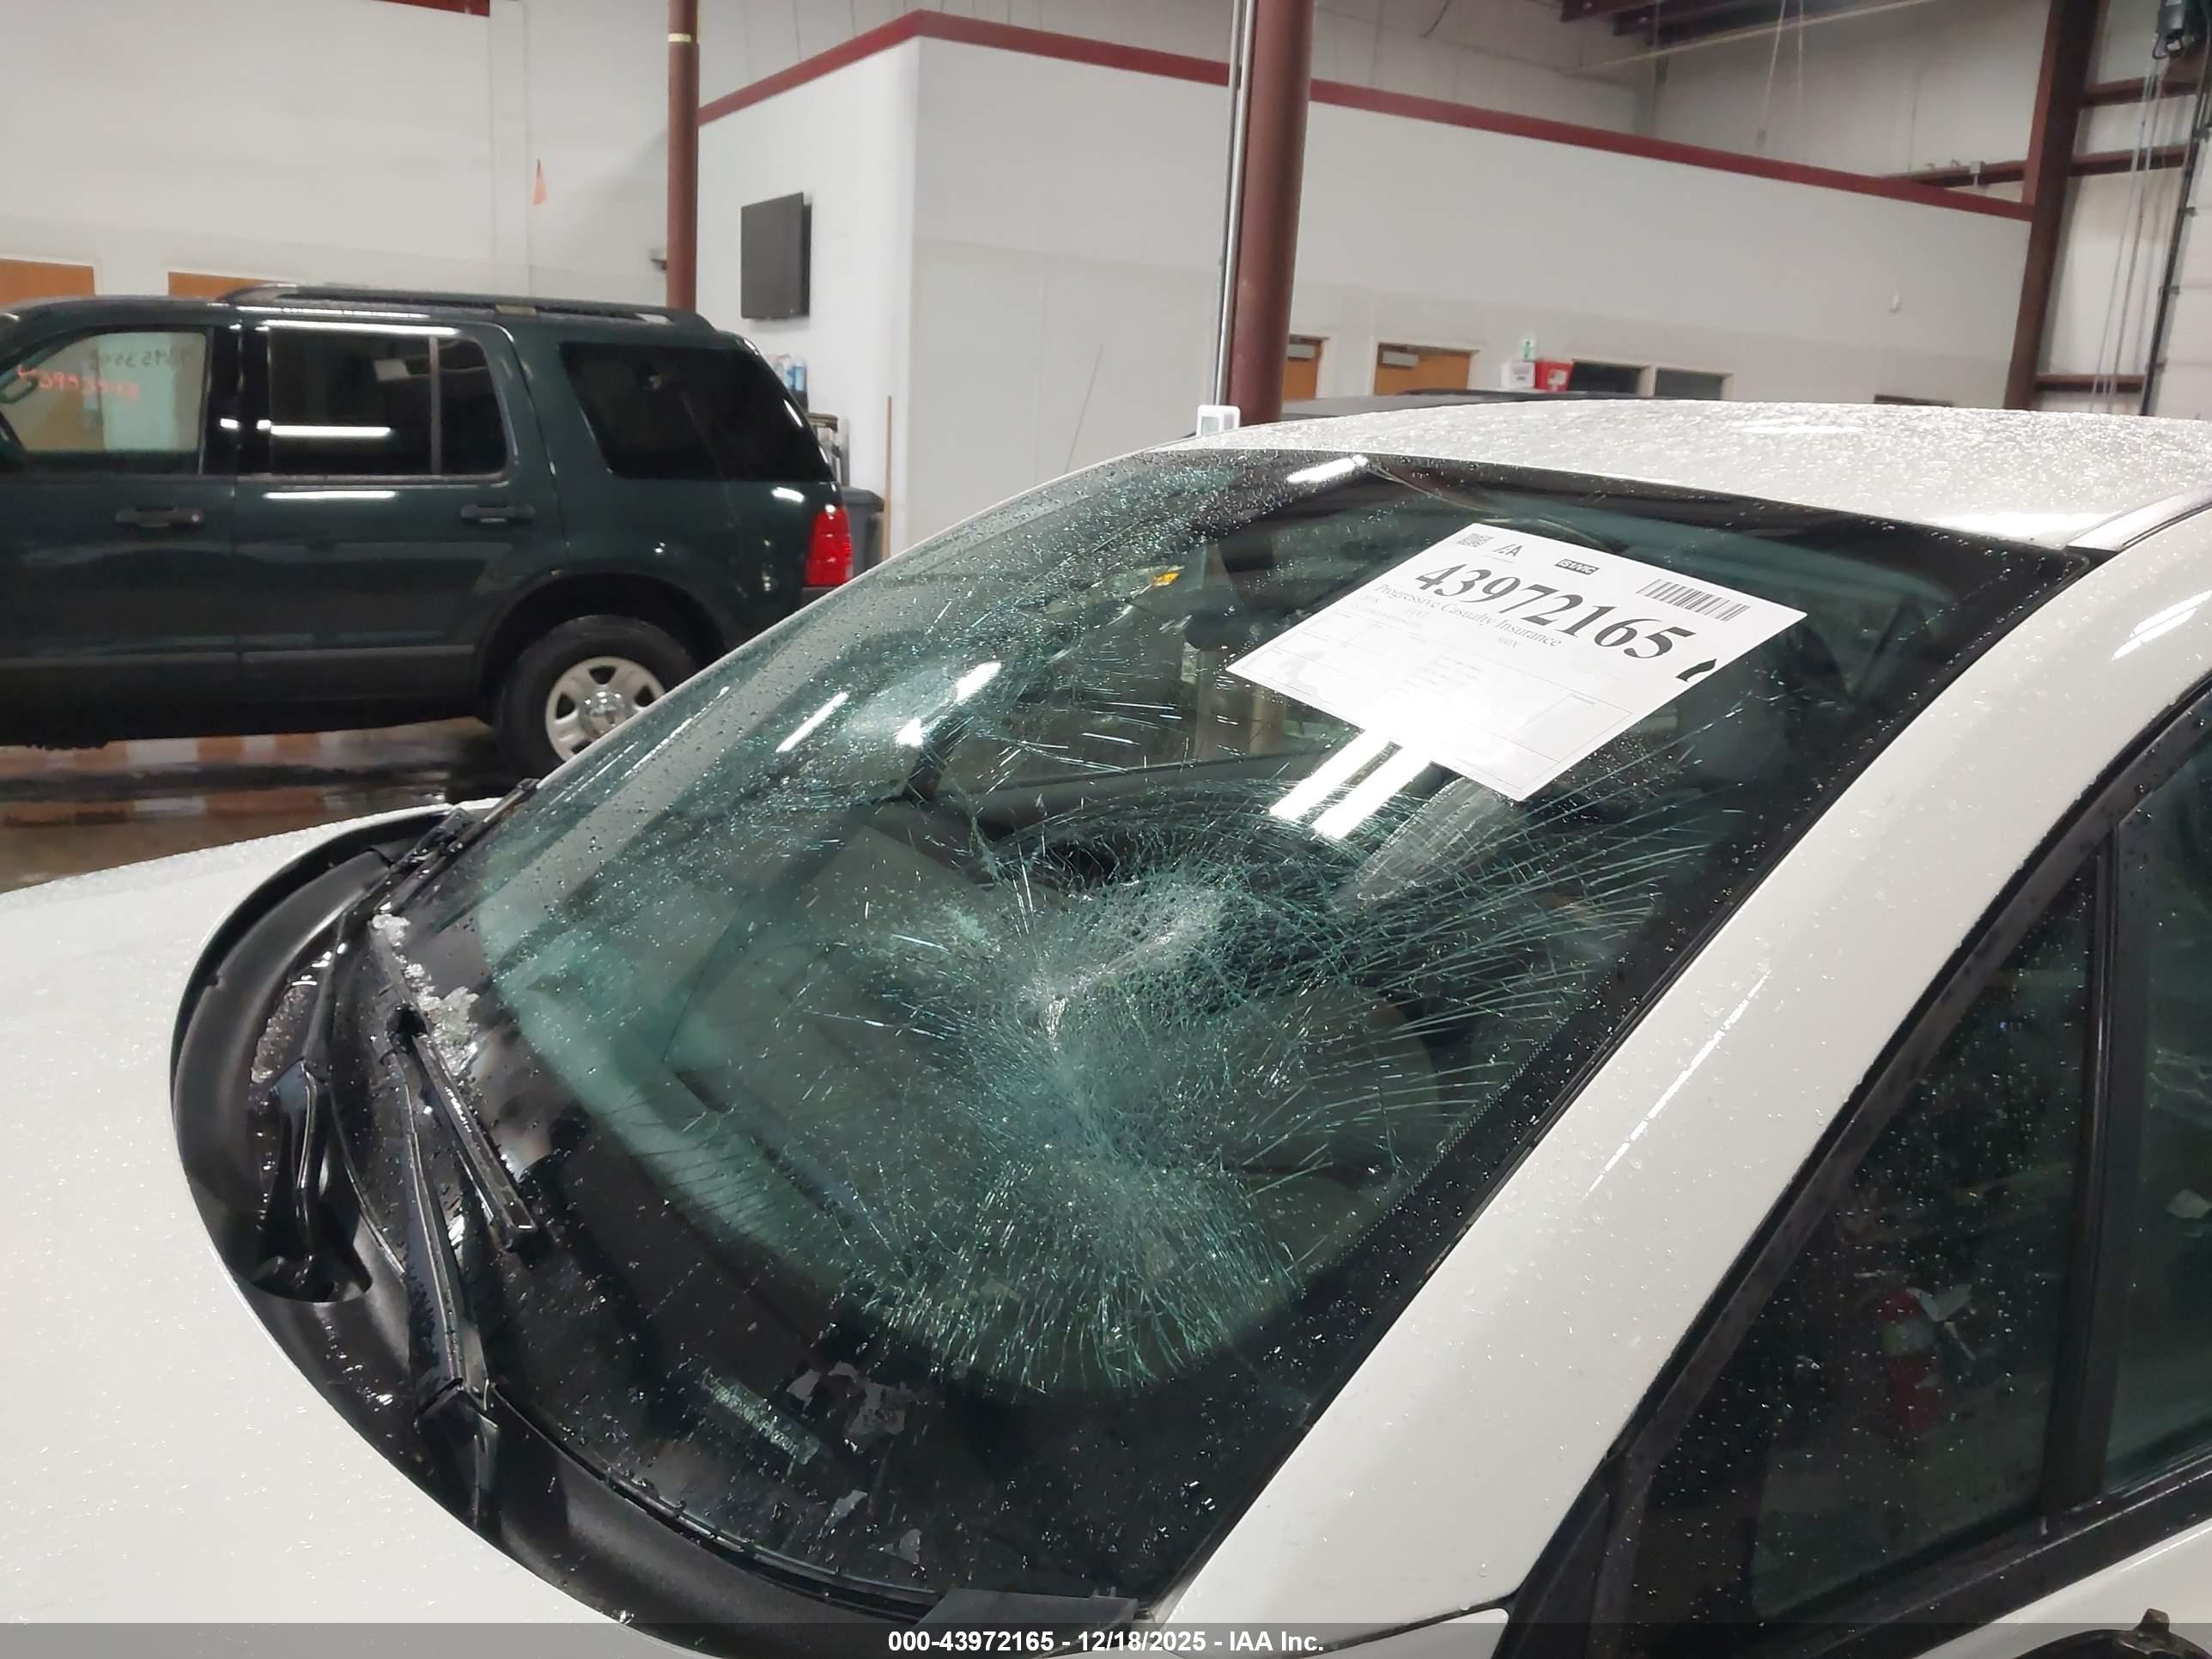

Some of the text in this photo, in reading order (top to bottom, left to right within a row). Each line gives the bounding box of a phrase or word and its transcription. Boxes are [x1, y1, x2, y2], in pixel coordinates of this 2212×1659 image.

[1375, 583, 1442, 609] Progressive
[1441, 602, 1496, 626] Casualty
[1495, 617, 1562, 647] Insurance
[1416, 563, 1696, 659] 43972165
